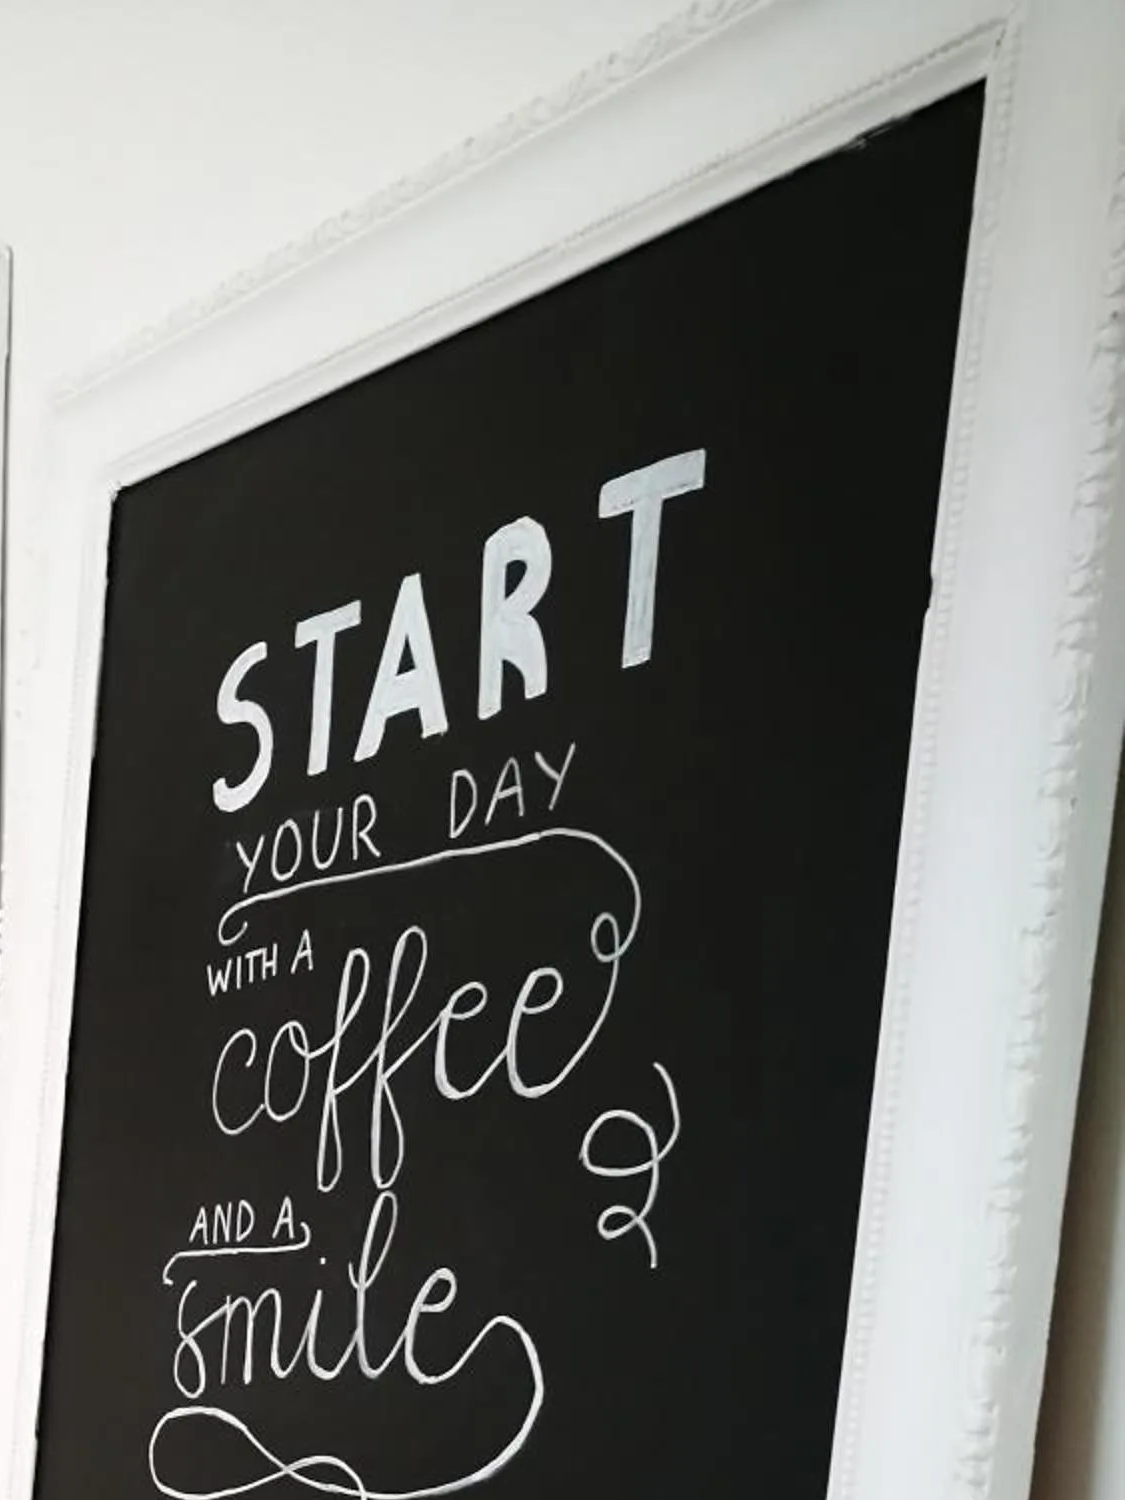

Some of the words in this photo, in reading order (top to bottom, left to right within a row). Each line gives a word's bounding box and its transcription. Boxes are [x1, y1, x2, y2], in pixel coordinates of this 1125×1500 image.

[212, 448, 707, 813] START
[235, 793, 382, 894] YOUR
[449, 742, 576, 839] DAY
[206, 942, 278, 997] WITH
[290, 928, 314, 975] A
[212, 925, 595, 1193] coffee
[188, 1199, 256, 1246] AND
[271, 1195, 296, 1241] A
